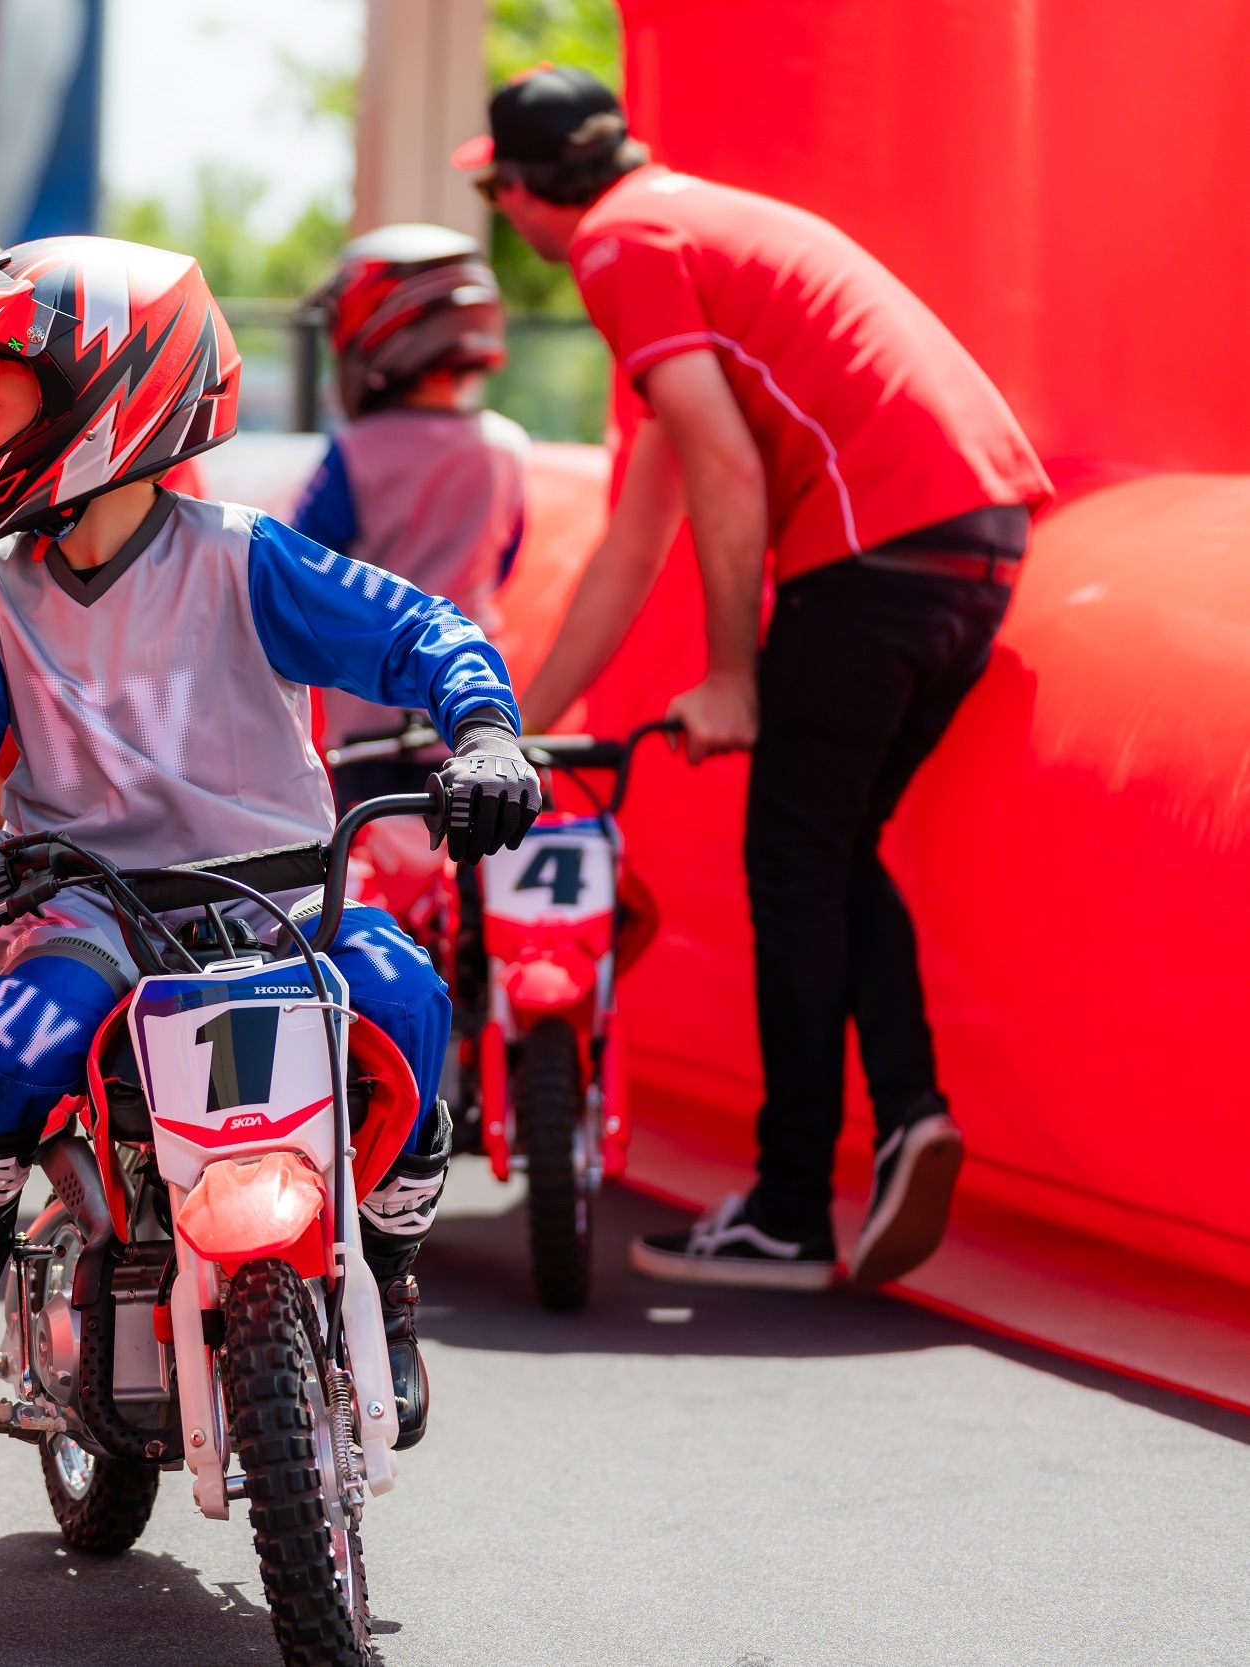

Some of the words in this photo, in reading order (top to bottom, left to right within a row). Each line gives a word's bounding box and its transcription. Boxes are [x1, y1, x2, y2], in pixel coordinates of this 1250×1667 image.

[26, 665, 197, 793] FLY
[470, 758, 528, 782] FLY
[514, 846, 587, 905] 4
[254, 986, 313, 995] HONDA
[195, 1006, 280, 1113] 1
[230, 1116, 262, 1130] SKDA
